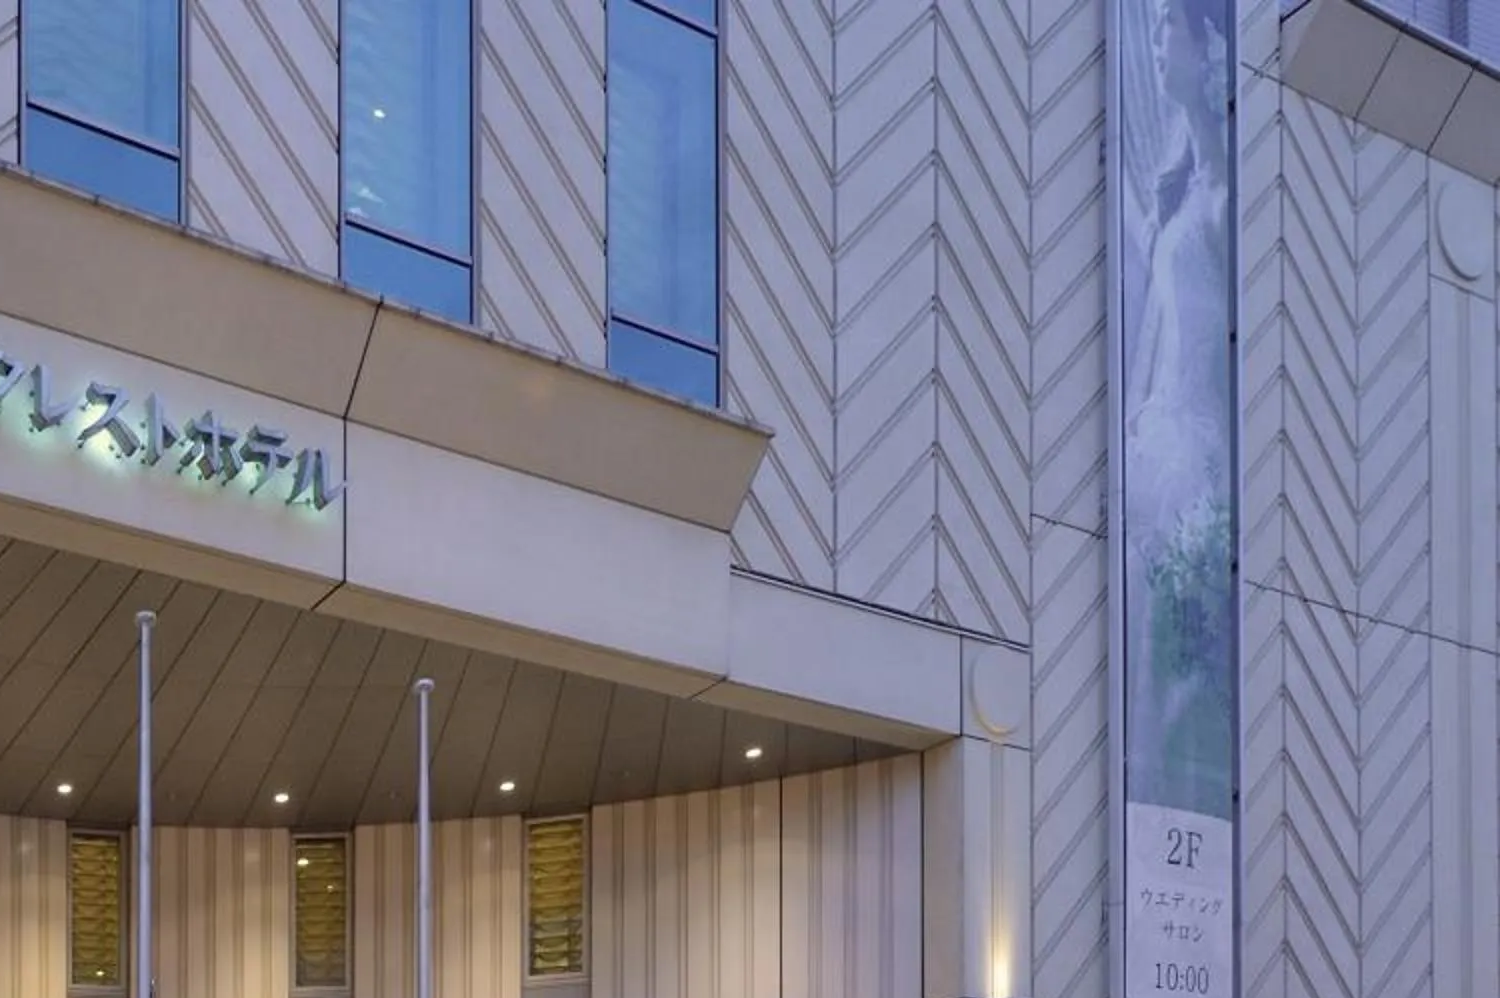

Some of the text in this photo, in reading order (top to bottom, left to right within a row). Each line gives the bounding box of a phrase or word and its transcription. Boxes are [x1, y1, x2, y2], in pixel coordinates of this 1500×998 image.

[1167, 827, 1203, 869] 2F
[1163, 920, 1205, 942] サロン
[1155, 963, 1210, 995] 10:00
